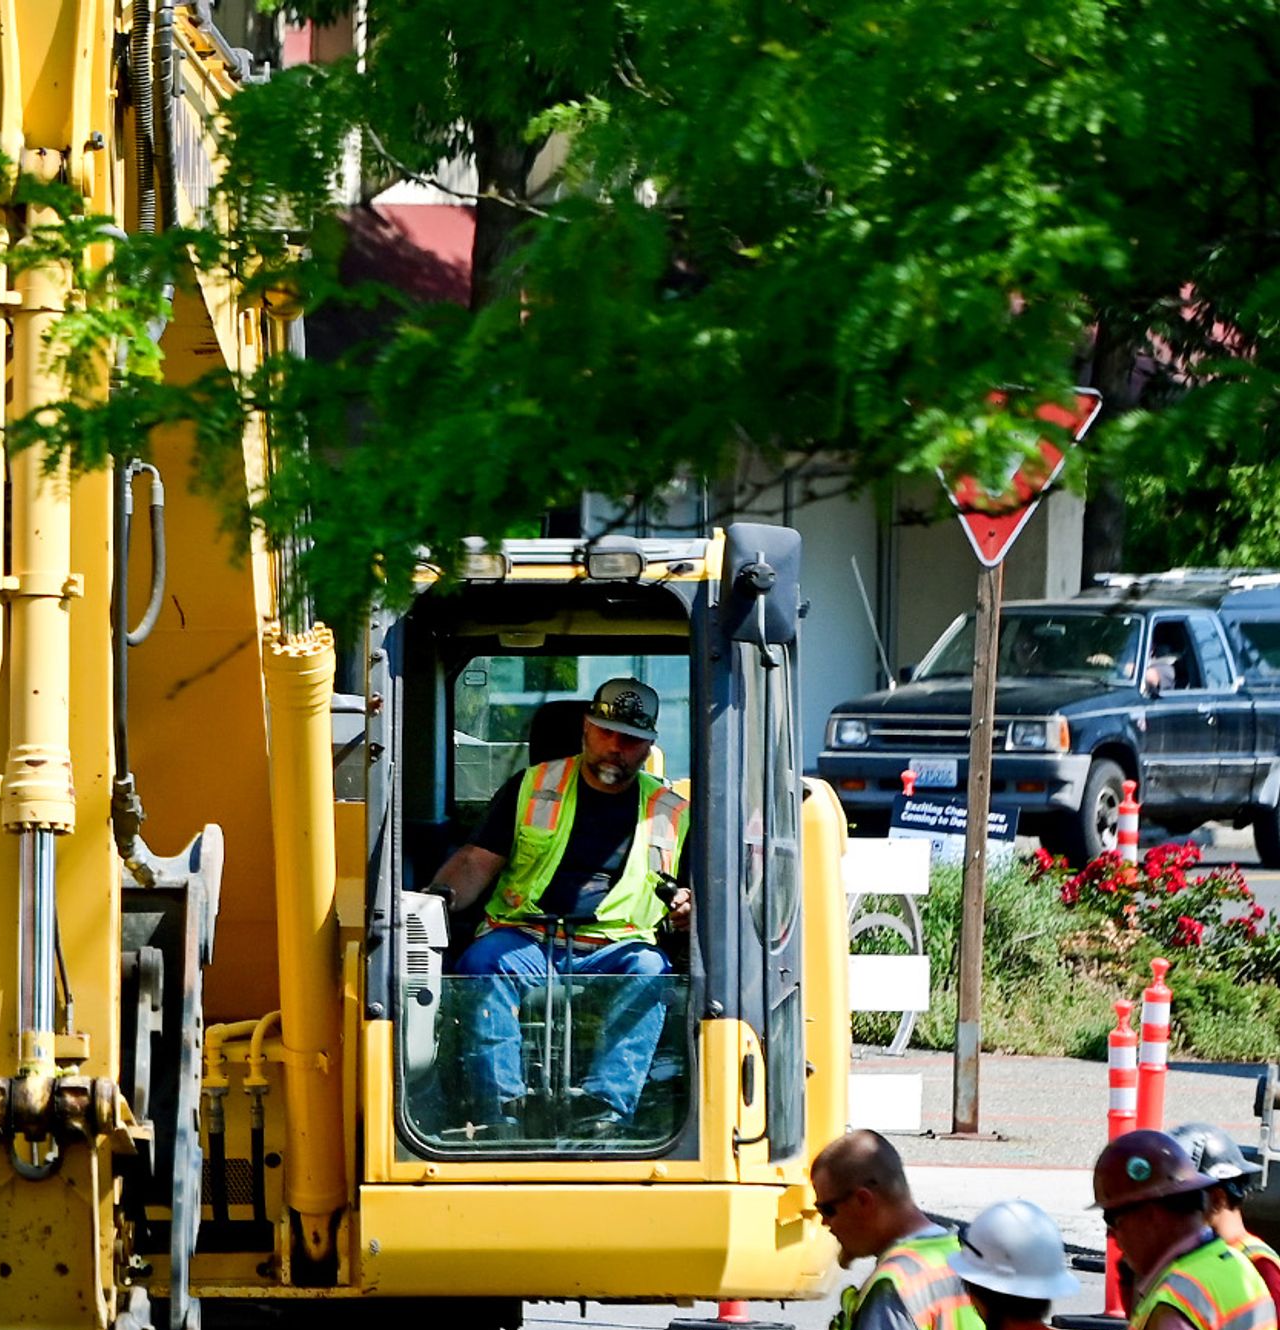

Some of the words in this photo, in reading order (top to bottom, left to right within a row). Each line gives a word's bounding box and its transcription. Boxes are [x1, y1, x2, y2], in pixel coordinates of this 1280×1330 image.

[901, 810, 938, 826] Coming
[938, 816, 949, 826] to
[905, 801, 944, 816] Exciting
[987, 812, 1006, 823] are
